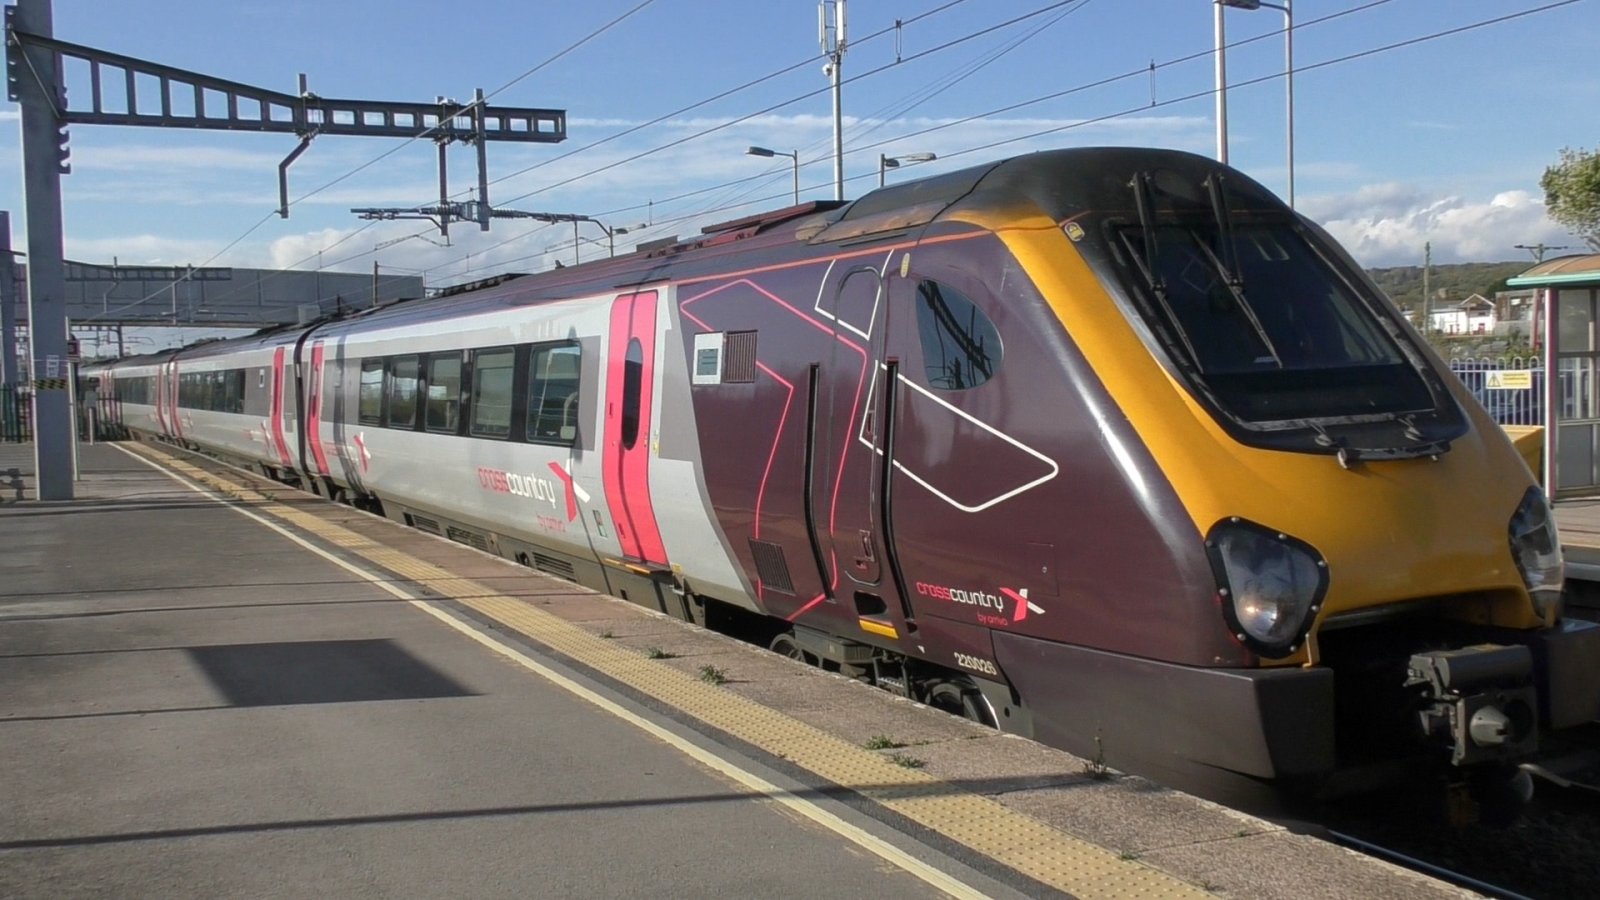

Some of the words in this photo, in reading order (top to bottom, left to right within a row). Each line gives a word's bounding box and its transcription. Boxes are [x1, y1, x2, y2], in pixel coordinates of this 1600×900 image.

[478, 467, 556, 509] crosscountry
[916, 582, 1004, 612] crosscountry
[954, 652, 997, 675] 220026
